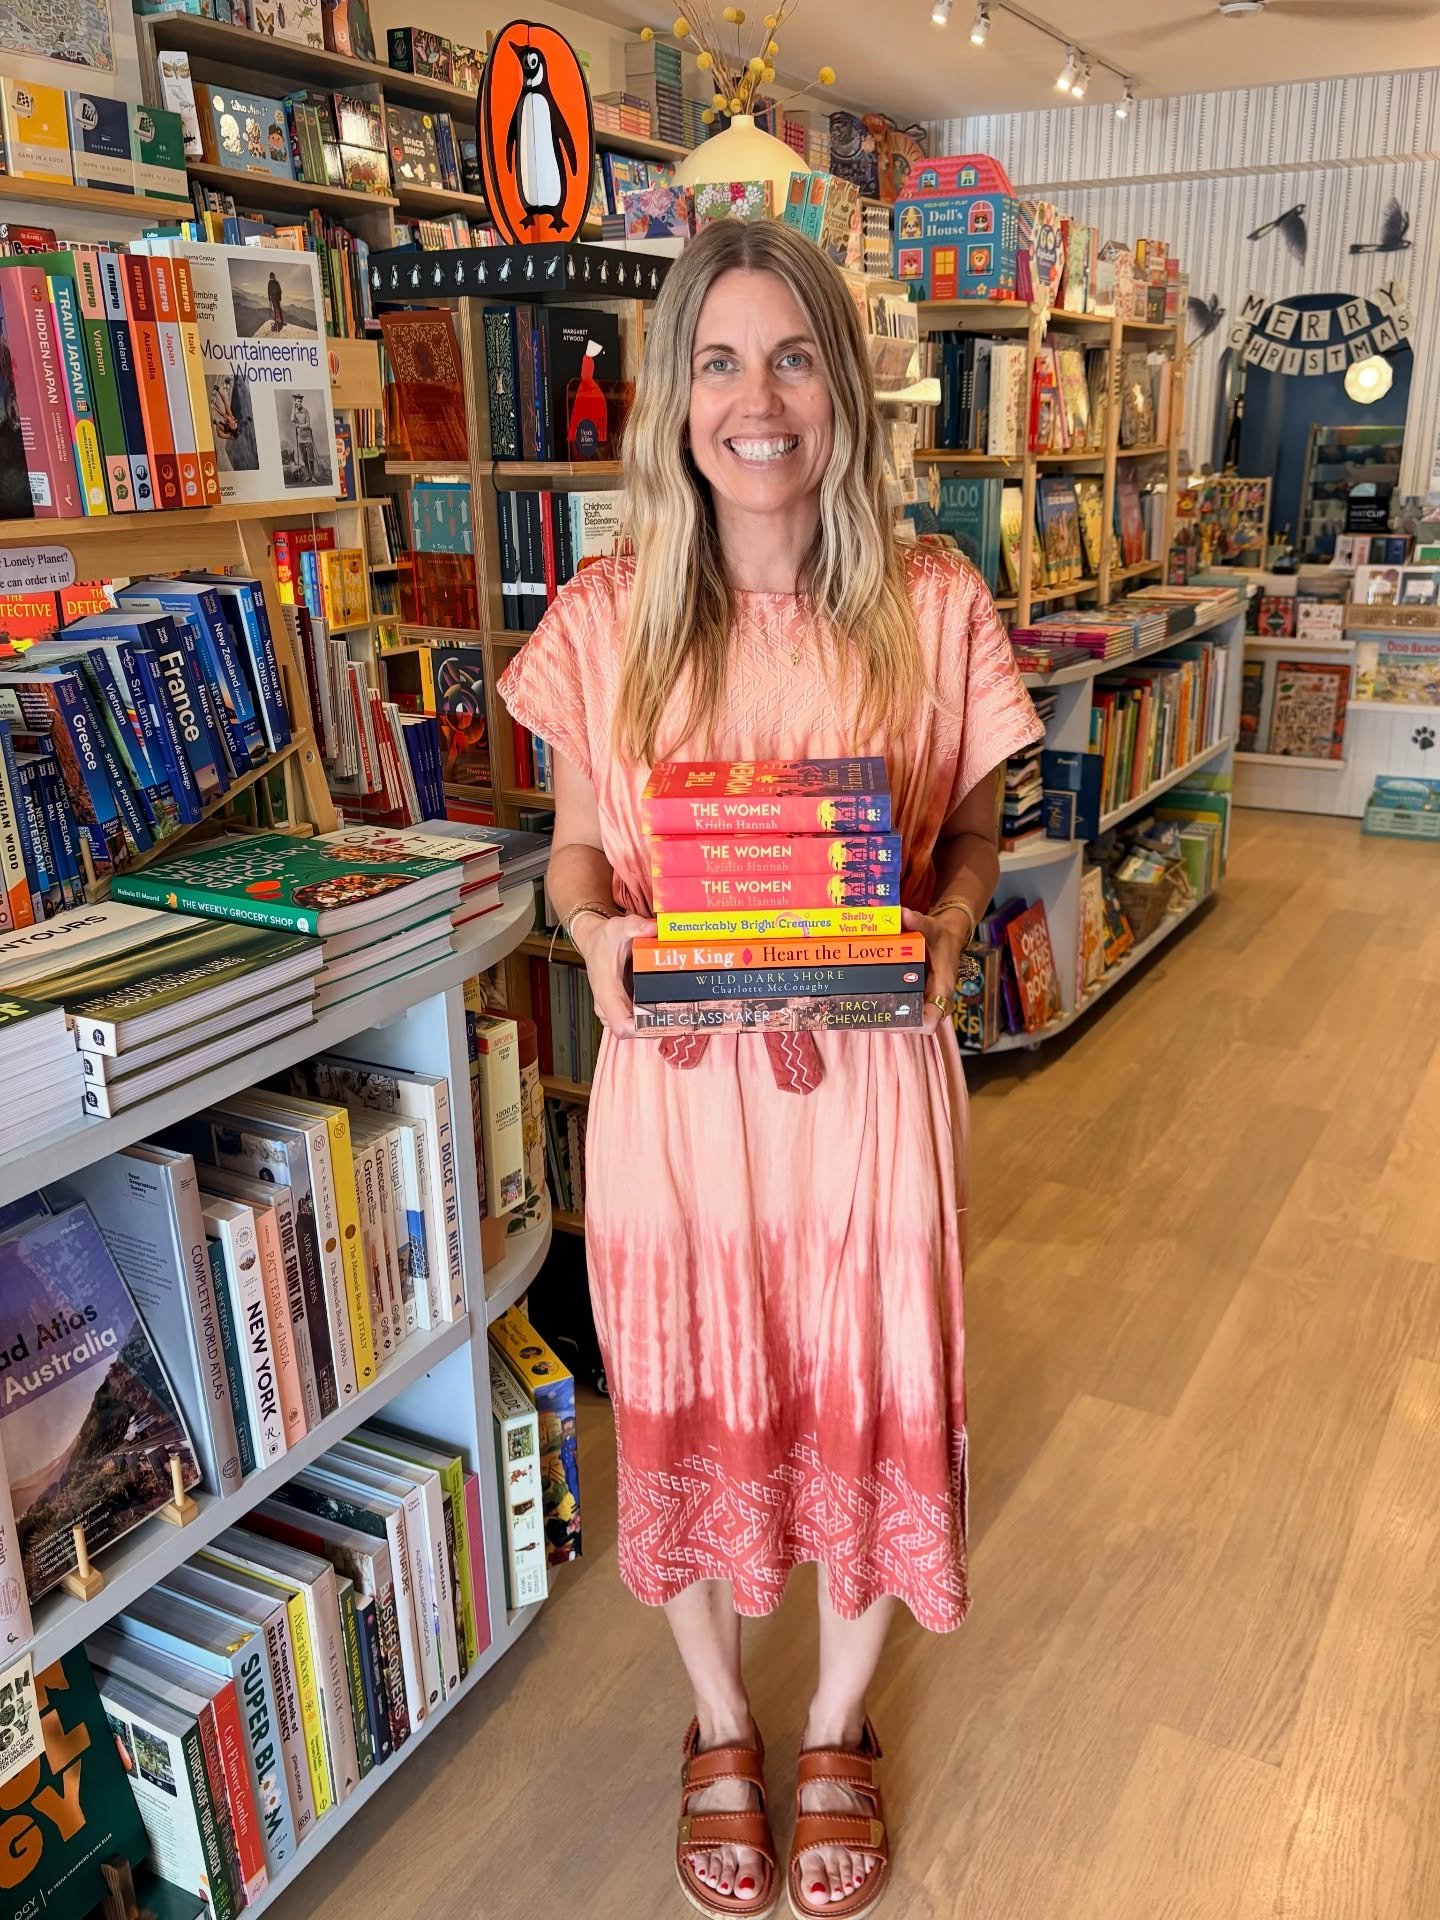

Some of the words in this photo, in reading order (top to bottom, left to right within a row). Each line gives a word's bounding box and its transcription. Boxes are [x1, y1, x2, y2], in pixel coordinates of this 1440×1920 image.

[402, 136, 424, 148] SPACE
[404, 146, 426, 158] BINGO
[926, 225, 966, 236] House
[929, 208, 962, 222] Doll's
[58, 288, 76, 340] TRAIN
[82, 262, 97, 308] INTREPID
[92, 330, 106, 376] Vietnam
[106, 264, 120, 310] INTREPID
[116, 331, 130, 371] Iceland
[134, 266, 147, 311] INTREPID
[144, 332, 156, 380] Australia
[156, 268, 170, 312] INTREPID
[166, 332, 176, 366] Japan
[178, 268, 190, 312] INTREPID
[188, 332, 196, 356] Italy
[1241, 281, 1396, 341] MERRY
[562, 328, 588, 336] MARGARET
[562, 334, 584, 342] ATWOOD
[1230, 315, 1410, 369] CHRISTMAS
[34, 308, 51, 359] HIDDEN
[43, 362, 58, 404] JAPAN
[200, 339, 319, 366] Mountaineering
[66, 344, 85, 395] JAPAN
[230, 362, 292, 383] Women
[584, 518, 619, 526] Dependency
[296, 536, 307, 544] KAZ
[4, 556, 35, 568] Lonely
[38, 553, 68, 566] Planet?
[7, 580, 24, 588] can
[26, 576, 48, 586] order
[50, 574, 57, 582] it
[58, 572, 70, 582] in!
[214, 623, 226, 646] New
[222, 648, 241, 688] Zealand
[264, 639, 275, 664] North
[132, 678, 144, 697] Sri
[256, 656, 272, 700] LONDON
[268, 664, 279, 688] Coast
[106, 682, 126, 726] Vietnam
[159, 650, 200, 743] France
[198, 684, 210, 715] Route
[206, 714, 214, 729] 66
[273, 688, 283, 707] 500
[136, 700, 153, 738] Lanka
[166, 712, 178, 747] Camino
[210, 682, 222, 705] NEW
[218, 709, 237, 752] ZEALAND
[73, 714, 97, 770] Greece
[176, 746, 182, 756] de
[178, 756, 191, 790] Santiago
[684, 771, 716, 788] THE
[724, 762, 756, 796] WOMEN
[104, 752, 120, 778] SPAIN
[116, 780, 123, 788] &
[121, 788, 144, 834] PORTUGAL
[35, 806, 46, 828] NEW
[47, 804, 56, 822] BALI
[690, 804, 719, 816] THE
[724, 803, 781, 817] WOMEN
[695, 819, 734, 830] Kristin
[736, 819, 778, 830] Hannah
[24, 795, 47, 873] AMSTERDAM
[40, 828, 50, 852] YORK
[56, 801, 74, 856] BARCELONA
[5, 834, 19, 870] WOOD
[44, 852, 55, 876] CITY
[158, 848, 270, 880] WEEKLY
[185, 844, 318, 885] GROCERY
[702, 846, 730, 858] THE
[734, 845, 792, 858] WOMEN
[706, 861, 743, 872] Kristin
[747, 860, 789, 872] Hannah
[136, 860, 201, 876] THE
[206, 863, 286, 890] SHOP
[702, 880, 730, 894] THE
[734, 880, 792, 894] WOMEN
[707, 896, 743, 908] Kristin
[748, 896, 789, 906] Hannah
[181, 898, 197, 910] THE
[198, 901, 229, 916] WEEKLY
[230, 907, 268, 923] GROCERY
[270, 914, 294, 928] SHOP
[669, 920, 738, 933] Remarkably
[741, 919, 776, 934] Bright
[778, 918, 832, 930] Creatures
[839, 924, 858, 934] Van
[860, 922, 878, 932] Pelt
[841, 912, 875, 923] Shelby
[763, 946, 809, 962] Heart
[815, 946, 842, 960] the
[848, 944, 894, 959] Lover
[1022, 919, 1048, 956] OPEN
[654, 950, 687, 968] Lily
[693, 948, 735, 968] King
[1030, 942, 1051, 972] THIS
[696, 974, 736, 986] WILD
[744, 972, 786, 984] DARK
[793, 971, 845, 982] SHORE
[712, 984, 763, 994] Charlotte
[768, 982, 830, 994] McConaghy
[1026, 968, 1054, 1003] BOOK
[648, 1014, 675, 1026] THE
[678, 1011, 770, 1025] GLASSMAKER
[826, 1012, 892, 1024] CHEVALIER
[838, 1000, 878, 1012] TRACY
[495, 1107, 511, 1120] 1000
[511, 1102, 520, 1112] PC
[440, 1122, 450, 1138] IL
[364, 1158, 374, 1204] Greece
[376, 1148, 385, 1192] Greece
[390, 1138, 402, 1192] Portugal
[442, 1142, 454, 1188] DOLCE
[445, 1195, 456, 1224] FAR
[279, 1210, 292, 1254] STORE
[330, 1258, 338, 1274] The
[448, 1233, 460, 1280] NIENTE
[191, 1244, 208, 1314] COMPLETE
[212, 1261, 224, 1290] PARIS
[284, 1253, 300, 1299] FRONT
[332, 1274, 341, 1306] Monocle
[352, 1258, 360, 1292] Monocle
[266, 1250, 284, 1320] PATTERNS
[278, 1332, 288, 1370] INDIA
[291, 1298, 306, 1324] NYC
[354, 1292, 362, 1312] Book
[36, 1304, 98, 1350] Atlas
[202, 1314, 217, 1360] WORLD
[246, 1300, 268, 1354] NEW
[358, 1320, 368, 1350] ITALY
[6, 1327, 118, 1405] Australia
[340, 1336, 348, 1368] JAPAN
[209, 1361, 224, 1401] ATLAS
[255, 1357, 278, 1423] YORK
[499, 1389, 521, 1410] WILDE
[396, 1520, 405, 1550] WITH
[399, 1550, 410, 1596] NATURE
[379, 1582, 397, 1635] BUSH
[277, 1618, 285, 1636] The
[280, 1637, 292, 1693] Complete
[352, 1639, 362, 1678] VEGGIE
[328, 1652, 344, 1717] KINFOLK
[385, 1636, 406, 1720] FLOWERS
[240, 1652, 270, 1751] SUPER
[287, 1692, 295, 1718] Book
[224, 1724, 235, 1746] Cut
[292, 1721, 298, 1734] of
[228, 1748, 242, 1789] Flower
[186, 1736, 208, 1806] FUTUREPROOF
[200, 1805, 212, 1836] YOUR
[206, 1835, 221, 1878] GARDEN
[235, 1791, 248, 1836] Garden
